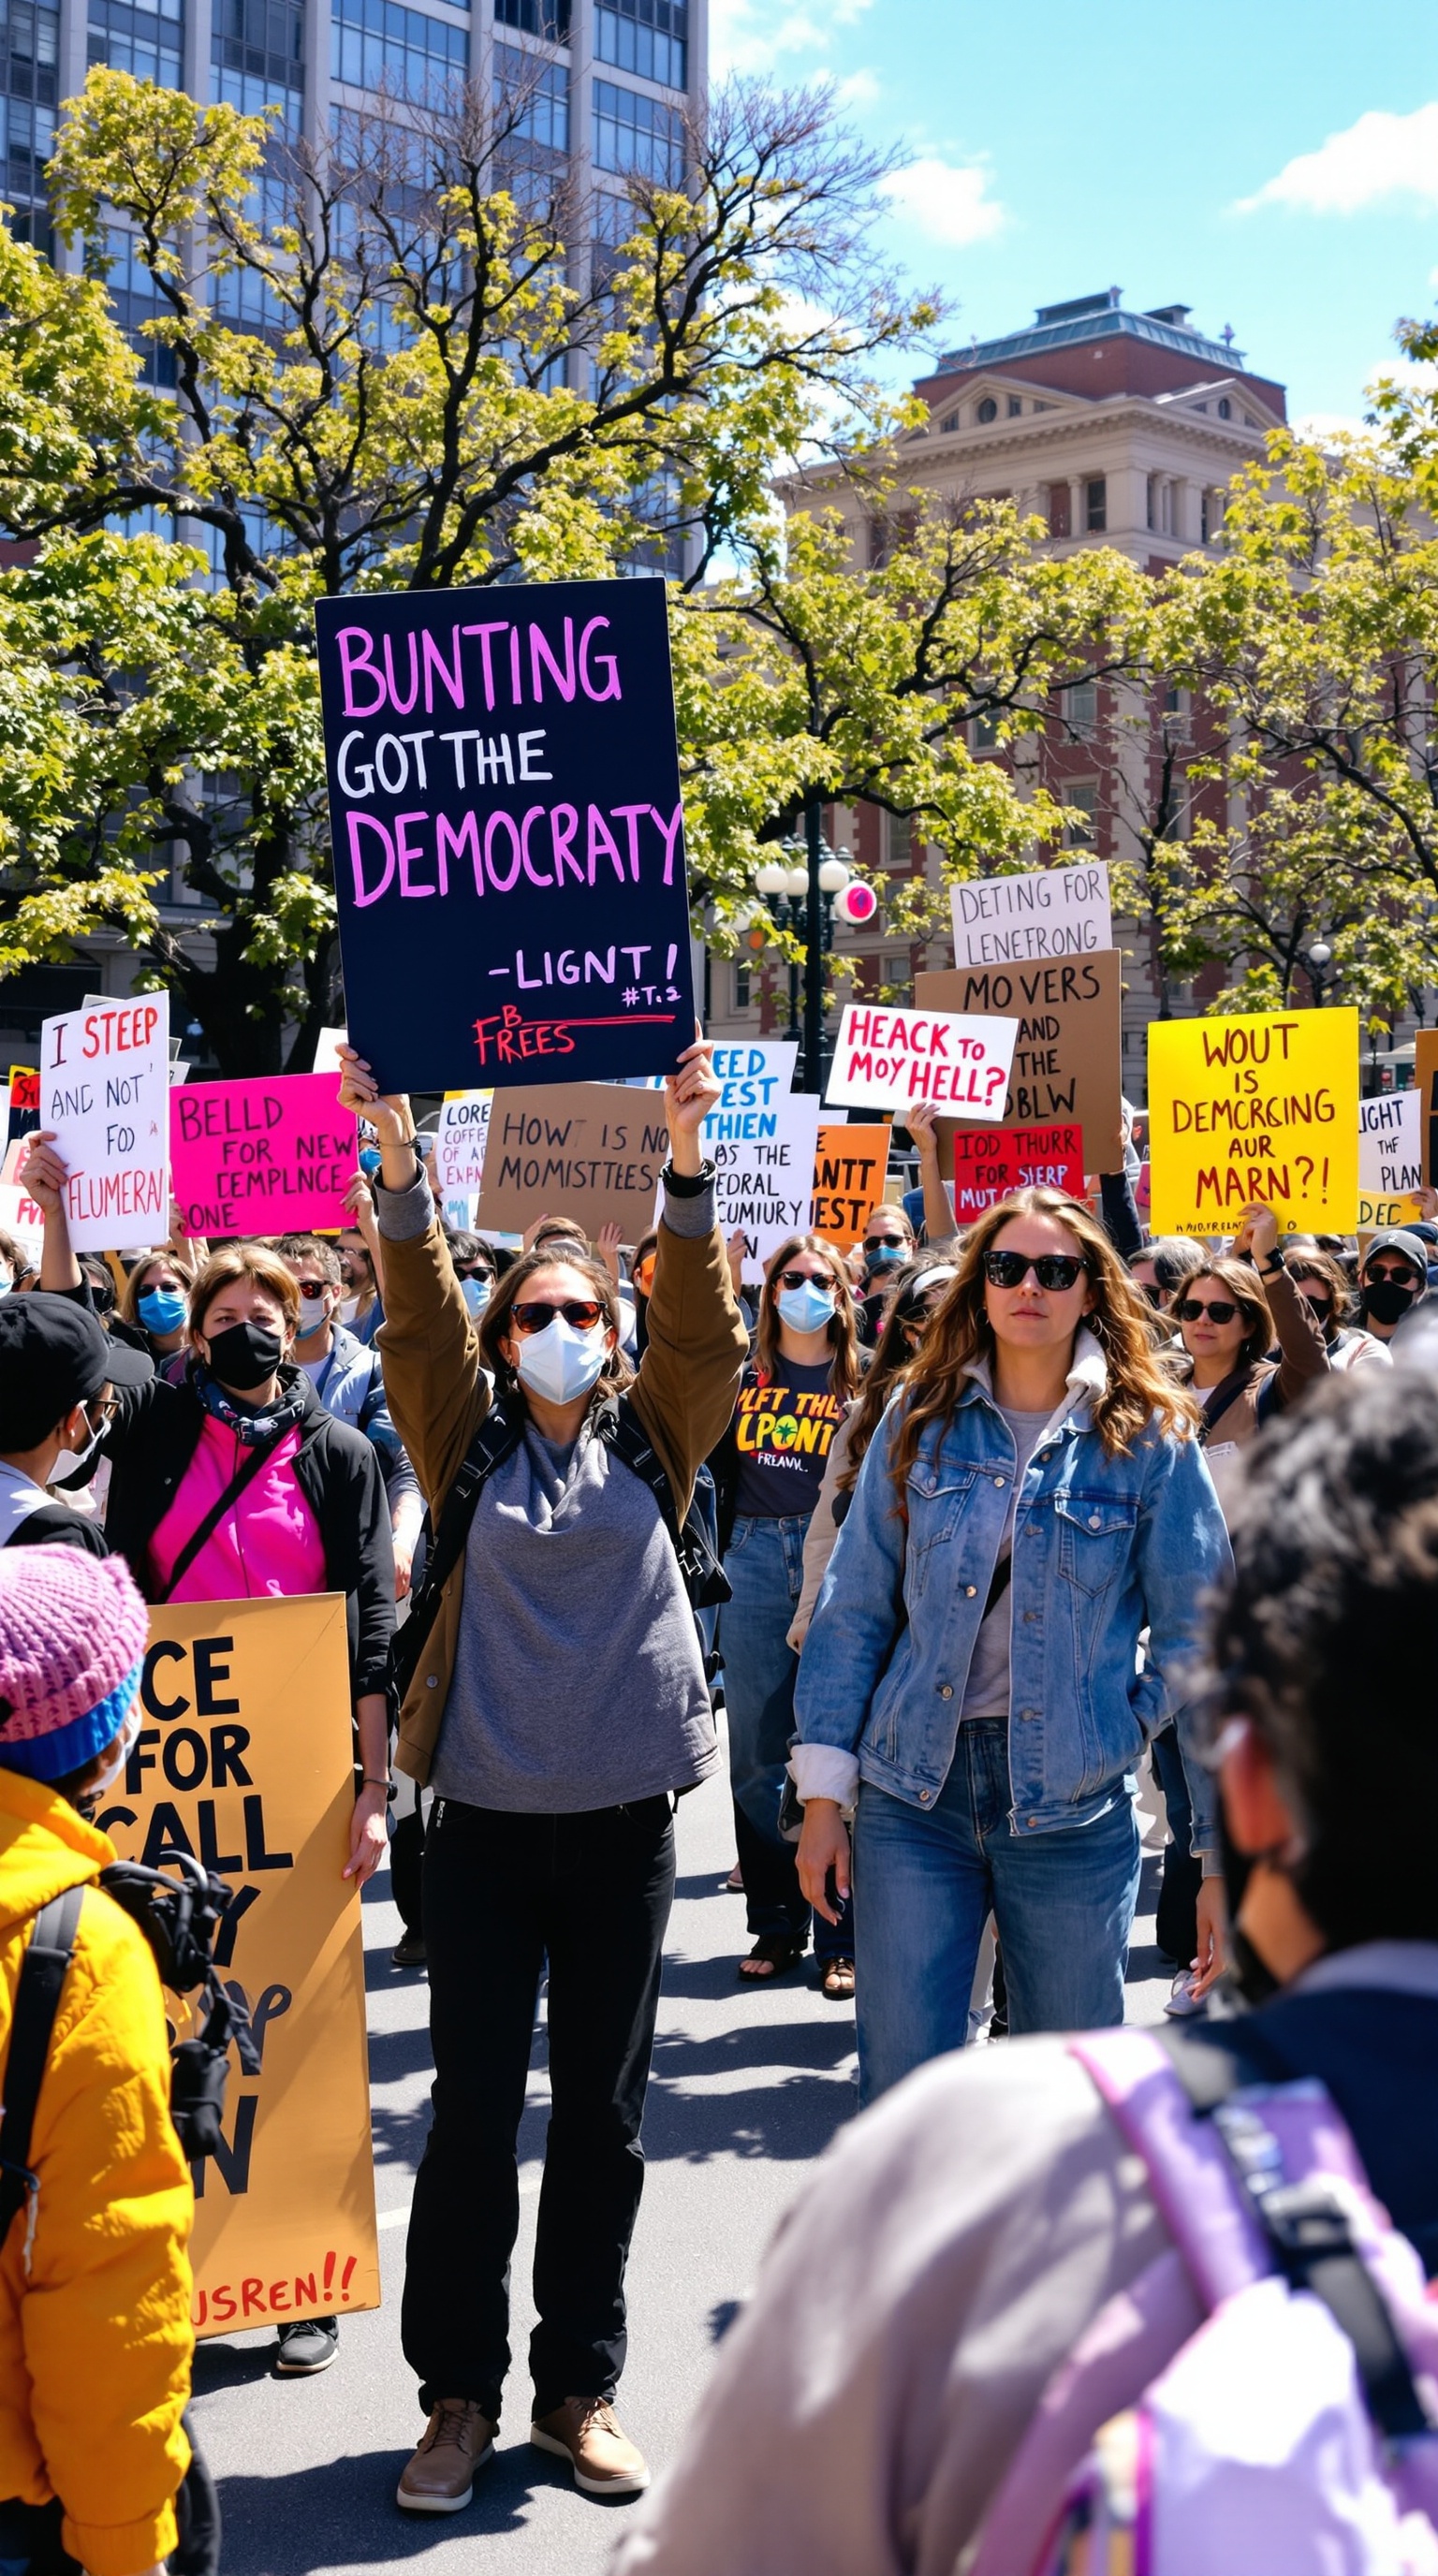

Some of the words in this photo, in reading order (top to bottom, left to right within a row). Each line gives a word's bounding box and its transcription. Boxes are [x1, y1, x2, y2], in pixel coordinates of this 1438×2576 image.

[336, 616, 621, 716] BUNTING
[338, 730, 434, 798] GOT
[440, 729, 553, 790] THE
[345, 802, 683, 907] DEMOCRATY
[960, 877, 1051, 924] DETING
[1064, 869, 1105, 903] FOR
[963, 965, 1101, 1011] MOVERS
[50, 1023, 68, 1069] I
[82, 1007, 158, 1059] STEEP
[847, 1010, 950, 1058] HEACK
[958, 1037, 985, 1061] TO
[1202, 1023, 1299, 1068] WOUT
[907, 1061, 1006, 1106] HELL?
[1016, 1049, 1062, 1076] THE
[1234, 1069, 1259, 1094] IS
[106, 1074, 144, 1109] NOT
[179, 1097, 284, 1143] BELLD
[601, 1124, 628, 1150] IS
[222, 1138, 273, 1166] FOR
[296, 1134, 355, 1161] NEW
[753, 1144, 792, 1167] THE
[1228, 1134, 1276, 1160] AUR
[975, 1163, 1009, 1185] FOR
[188, 1202, 240, 1232] ONE
[125, 1724, 255, 1795] FOR
